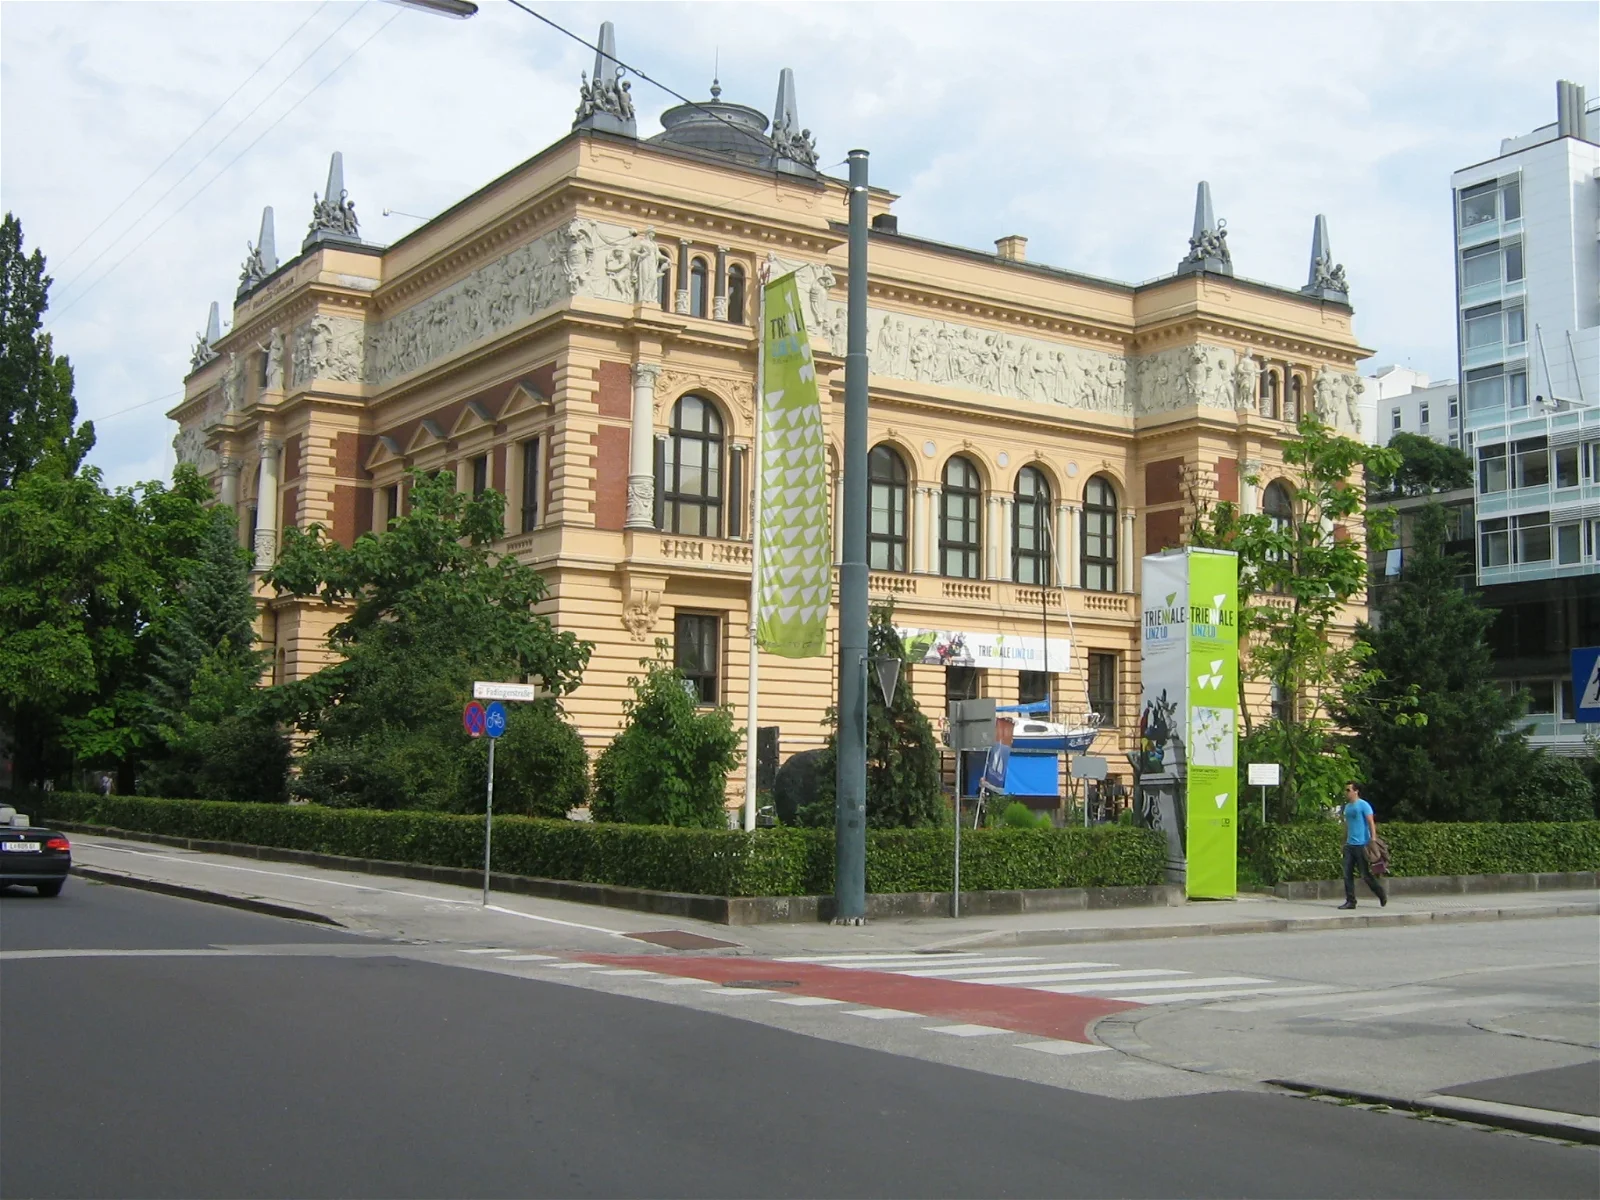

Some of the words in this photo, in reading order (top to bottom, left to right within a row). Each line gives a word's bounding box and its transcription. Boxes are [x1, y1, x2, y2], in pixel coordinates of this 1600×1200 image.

[1144, 607, 1185, 627] TRIENNALE
[1190, 606, 1234, 627] TRIENNALE
[1145, 627, 1159, 640] LINZ
[1191, 624, 1206, 638] LINZ
[978, 645, 1010, 659] TRIENNALE
